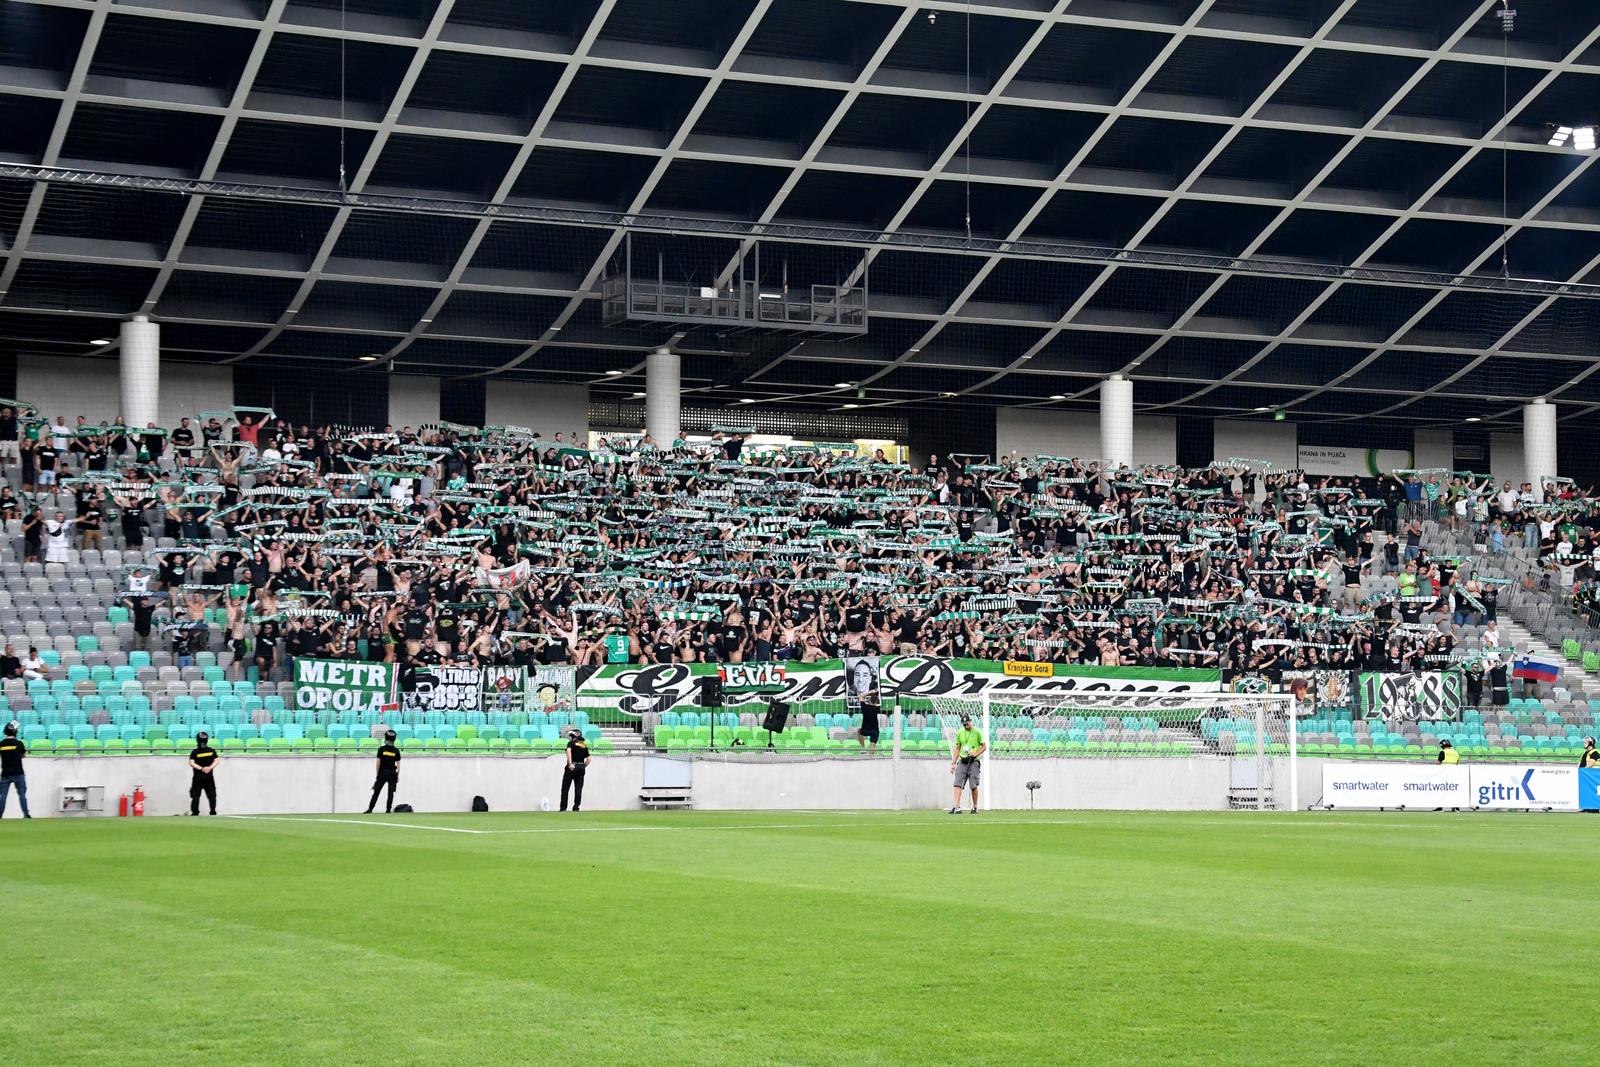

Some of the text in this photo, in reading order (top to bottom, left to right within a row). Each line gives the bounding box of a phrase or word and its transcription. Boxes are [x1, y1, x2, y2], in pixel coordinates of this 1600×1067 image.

[617, 640, 625, 652] 9
[298, 660, 387, 687] METR
[722, 662, 781, 687] EVL
[1008, 664, 1049, 673] Kranjska Gora
[296, 685, 386, 711] OPOLA
[1333, 780, 1389, 791] smartwater
[1403, 781, 1459, 792] smartwater
